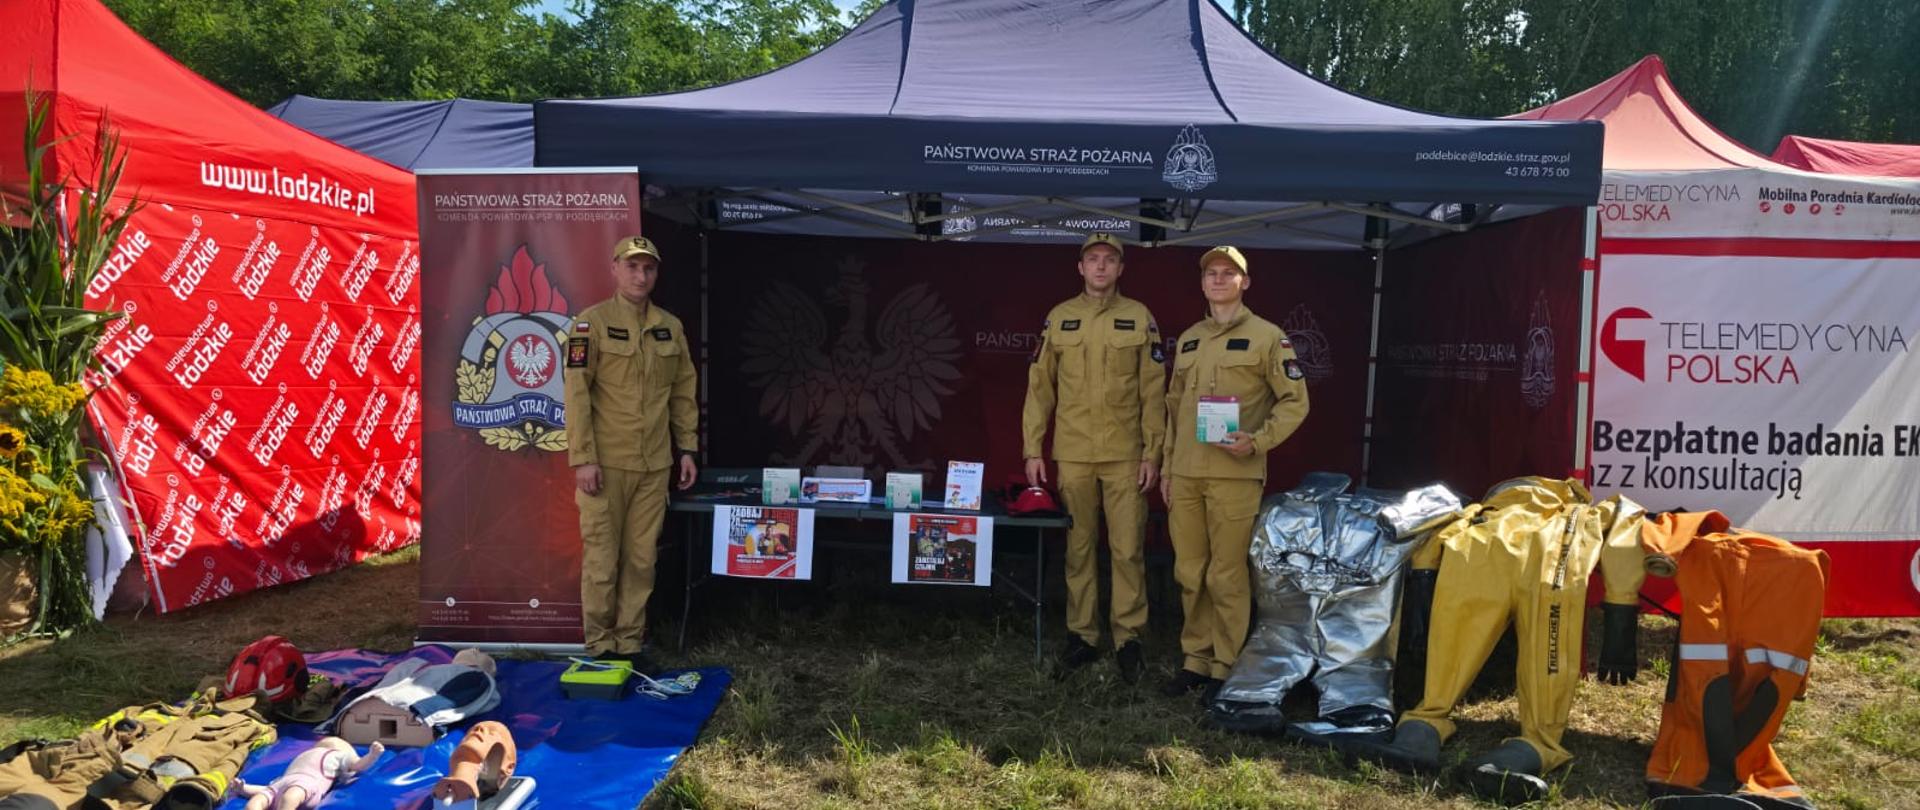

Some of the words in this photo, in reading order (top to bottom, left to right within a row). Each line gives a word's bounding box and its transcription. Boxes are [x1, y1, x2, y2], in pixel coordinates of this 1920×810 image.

[924, 142, 1026, 160] PAŃSTWOWA
[1030, 146, 1077, 162] STRAŻ
[1082, 147, 1154, 164] POŻARNA
[1416, 150, 1570, 164] poddebice@lodzkie.straz.gov.pl
[1505, 167, 1518, 176] 43
[1520, 167, 1540, 176] 678
[1542, 167, 1554, 177] 75
[1556, 168, 1570, 177] 00
[201, 161, 375, 217] www.lodzkie.pl
[436, 192, 520, 207] PAŃSTWOWA
[522, 192, 562, 206] STRAŻ
[566, 192, 627, 206] POŻARNA
[1602, 184, 1740, 202] ELEMEDYCYNA
[1758, 187, 1807, 202] Mobilna
[1810, 190, 1864, 204] Poradnia
[169, 237, 220, 301] łódzkie
[239, 241, 281, 300] łódzkie
[295, 246, 331, 303] łódzkie
[174, 322, 233, 389] łódzkie
[248, 322, 291, 385] łódzkie
[305, 322, 340, 380] łódzkie
[1660, 322, 1909, 352] TELEMEDYCYNA
[1668, 355, 1799, 384] POLSKA
[310, 398, 347, 459] łódzkie
[456, 405, 516, 424] PAŃSTWOWA
[520, 398, 547, 415] STRAŻ
[254, 402, 300, 467] łódzkie
[1593, 420, 1759, 461] Bezpłatne
[1768, 422, 1884, 457] badania
[1620, 465, 1635, 487] z
[1644, 456, 1801, 500] konsultacją
